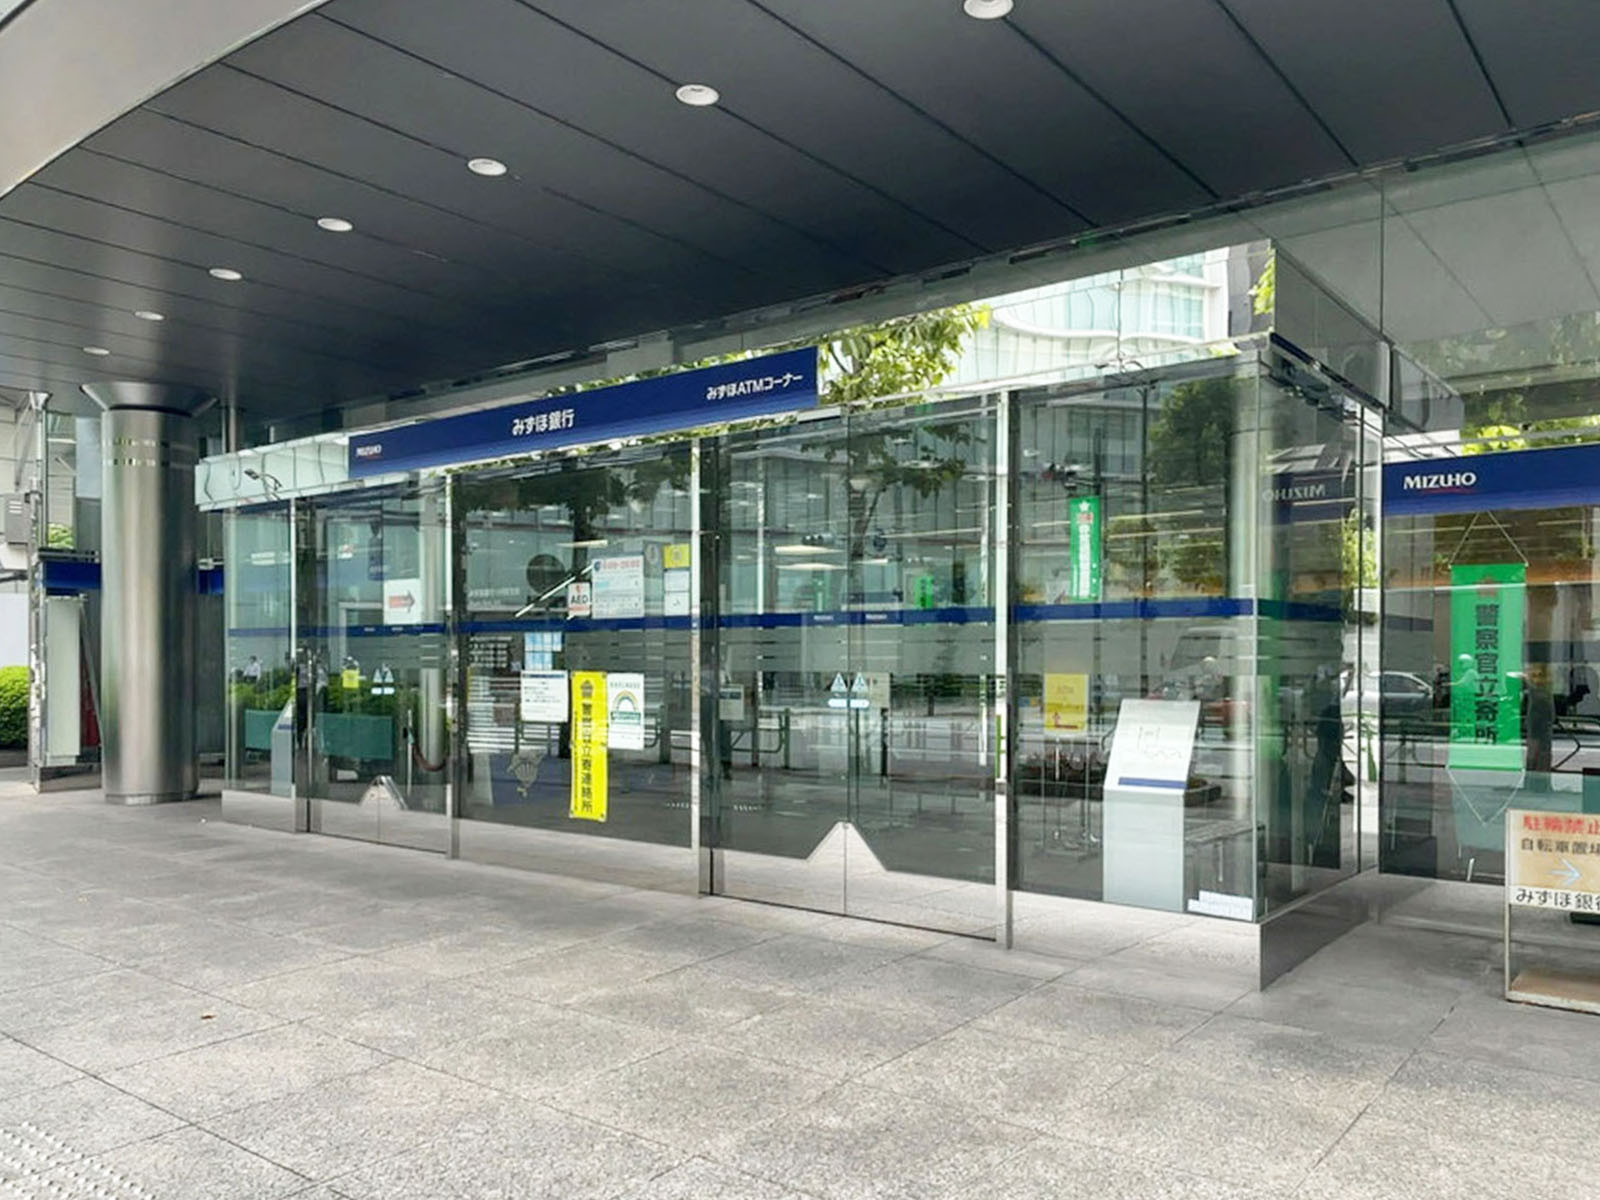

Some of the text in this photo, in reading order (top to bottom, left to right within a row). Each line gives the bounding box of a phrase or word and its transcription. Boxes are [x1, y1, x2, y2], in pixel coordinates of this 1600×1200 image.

[706, 372, 804, 401] みずほATMコーナー
[511, 408, 575, 437] みずほ銀行
[1403, 471, 1477, 490] MIZUHO
[1516, 888, 1600, 910] みずほ銀
